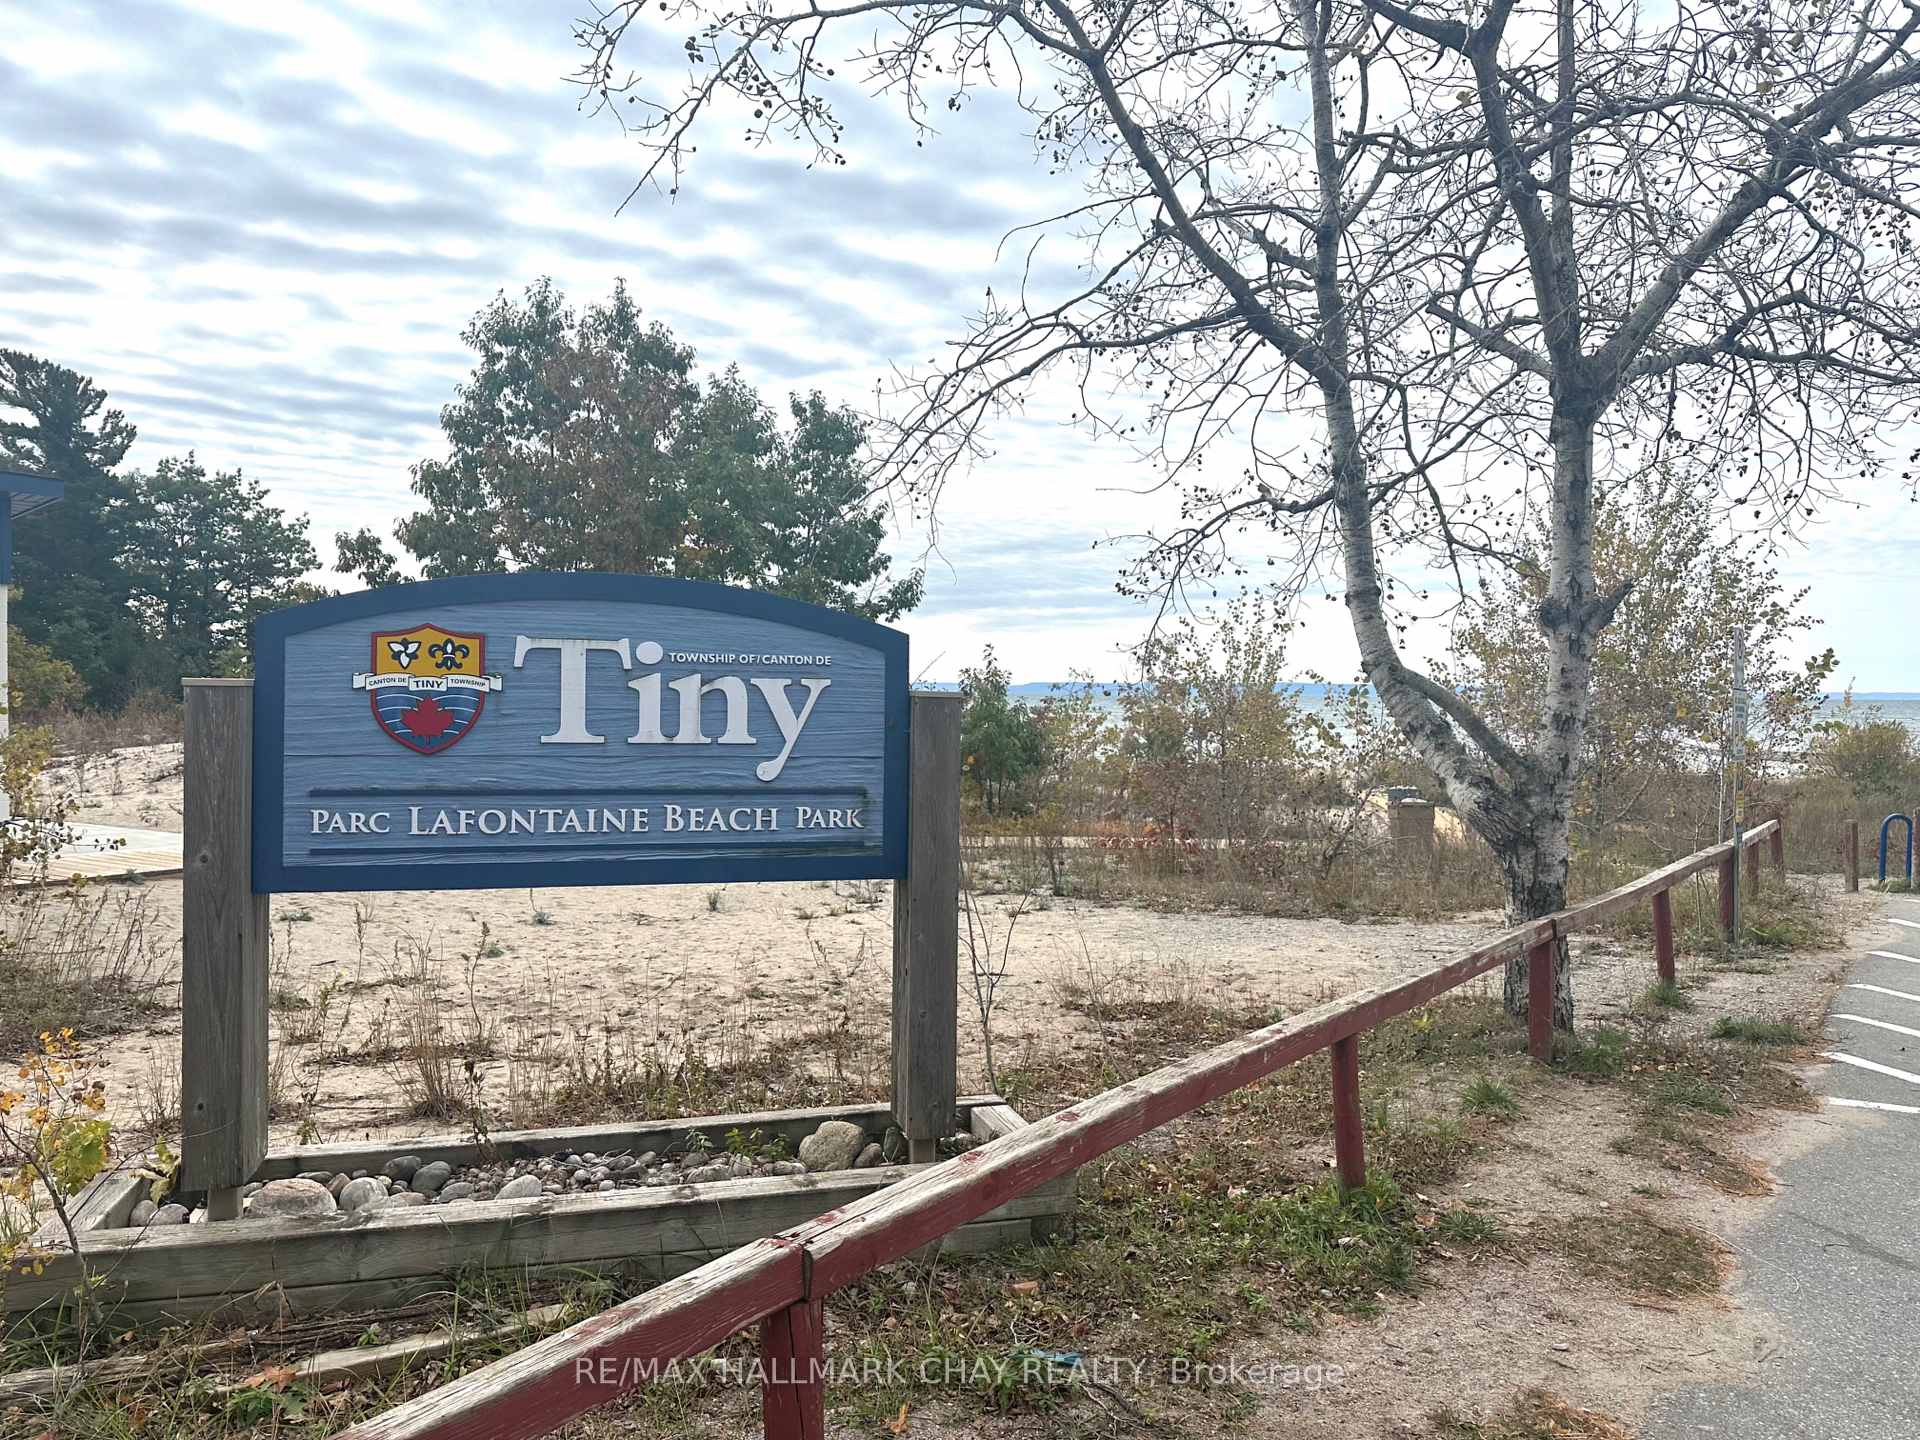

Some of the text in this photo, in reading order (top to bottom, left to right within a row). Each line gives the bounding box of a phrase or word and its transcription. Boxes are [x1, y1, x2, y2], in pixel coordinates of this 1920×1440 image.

[669, 652, 735, 664] TOWNSHIP
[816, 655, 832, 666] DE
[368, 676, 407, 687] CANTON DE
[413, 680, 444, 689] TINY
[450, 678, 486, 688] TOWNSHIP
[513, 635, 832, 782] Tiny
[310, 804, 865, 836] PARC LAFONTAINE BEACH PARK
